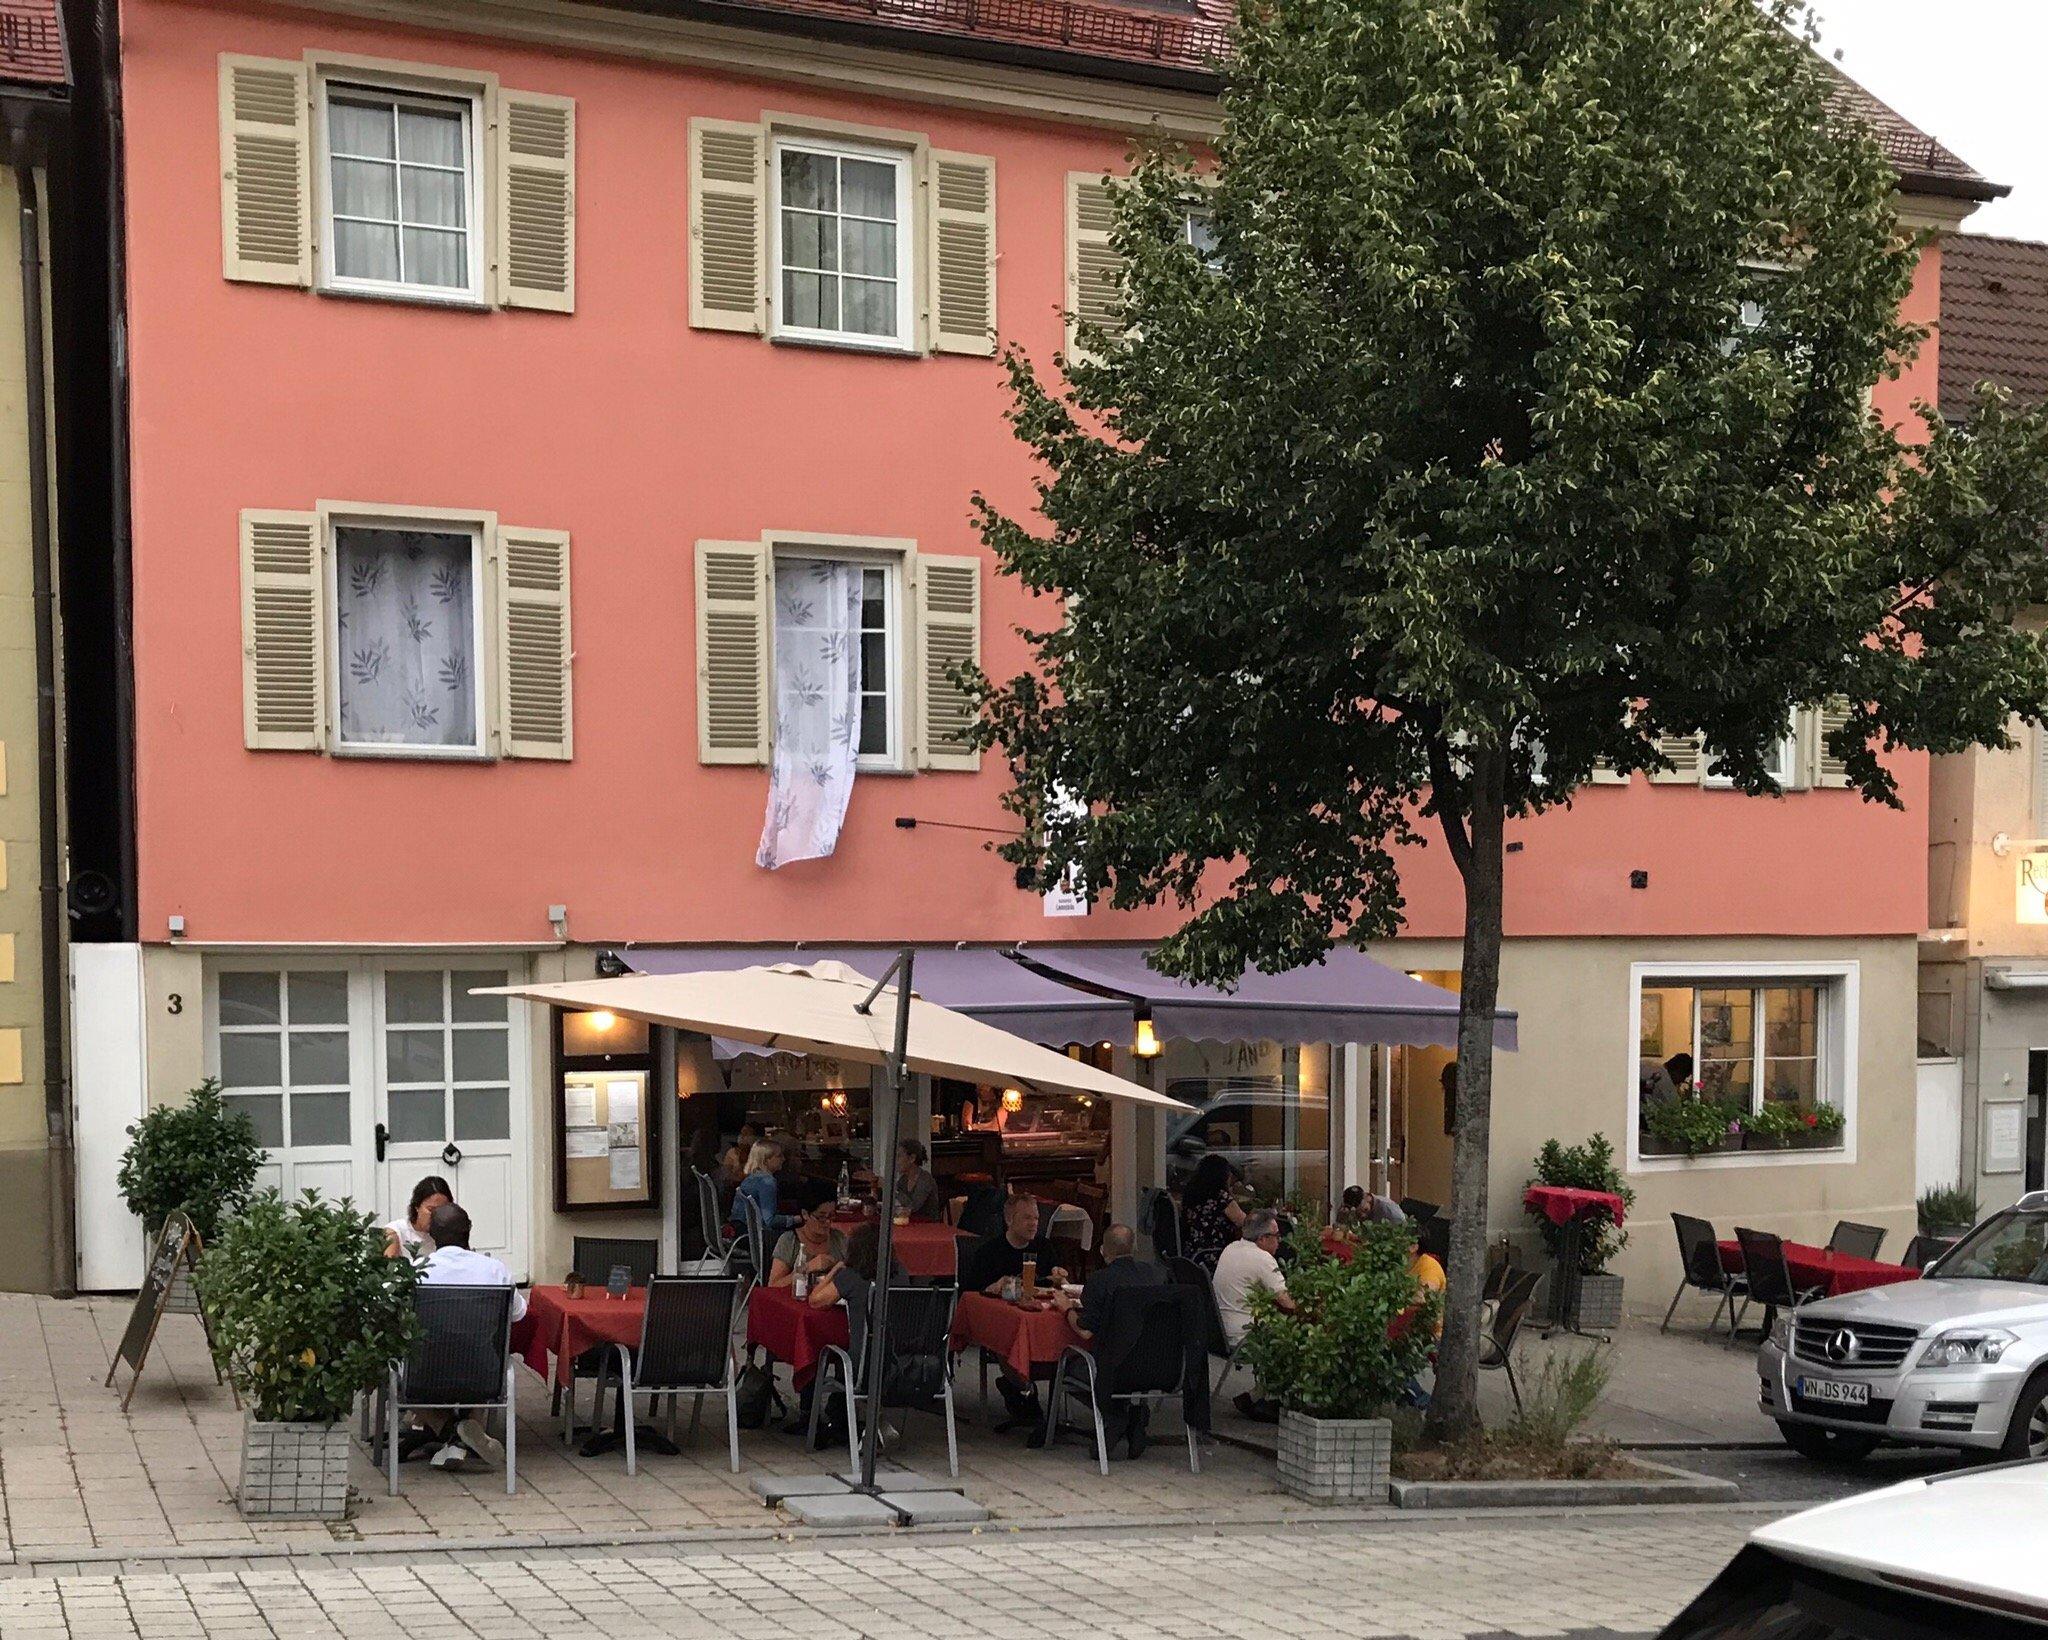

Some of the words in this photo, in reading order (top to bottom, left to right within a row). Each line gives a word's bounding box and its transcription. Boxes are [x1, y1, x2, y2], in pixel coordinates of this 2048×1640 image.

[167, 993, 183, 1015] 3
[1804, 1378, 1818, 1395] WN
[1825, 1383, 1840, 1398] DS
[1842, 1384, 1866, 1402] 944
